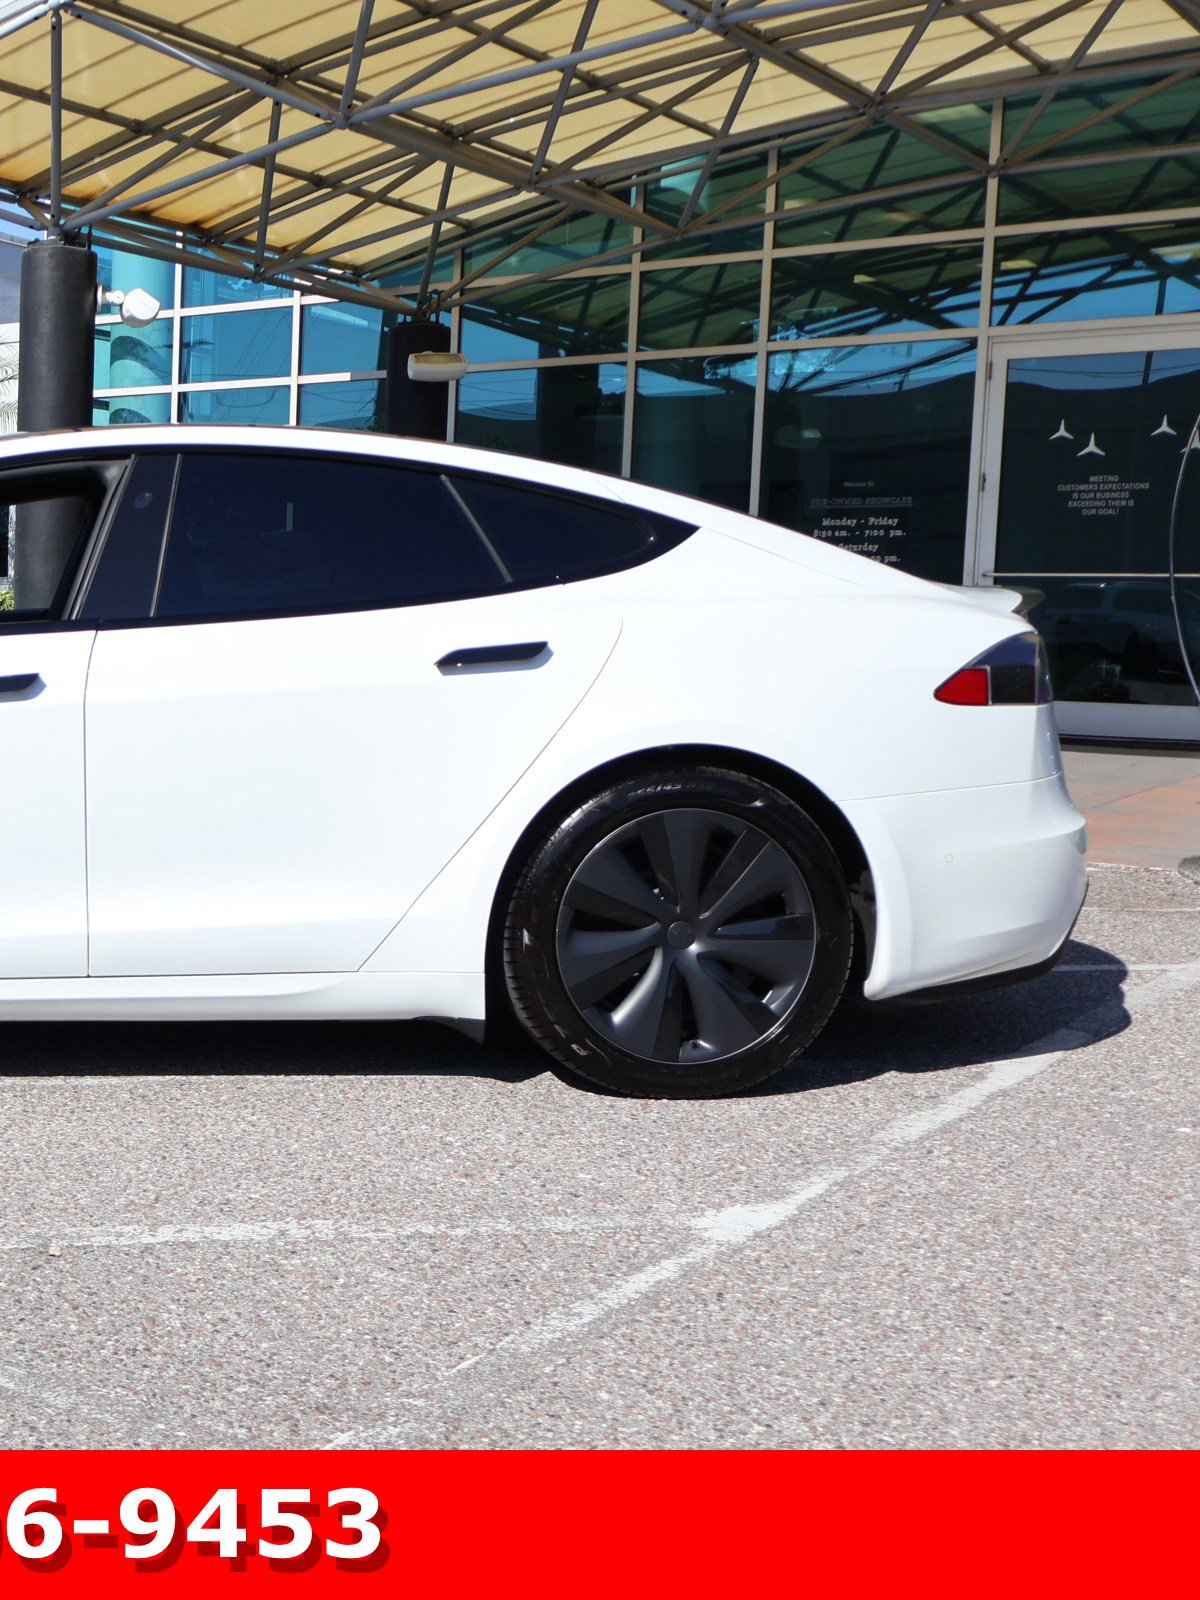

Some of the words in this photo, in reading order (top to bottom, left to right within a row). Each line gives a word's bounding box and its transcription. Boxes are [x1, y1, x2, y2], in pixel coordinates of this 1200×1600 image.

[1100, 482, 1150, 490] EXPECTATIONS
[822, 517, 858, 527] Monday
[868, 516, 899, 527] Friday
[864, 529, 885, 537] 7:00
[889, 529, 906, 537] pm.
[884, 555, 901, 563] pm.
